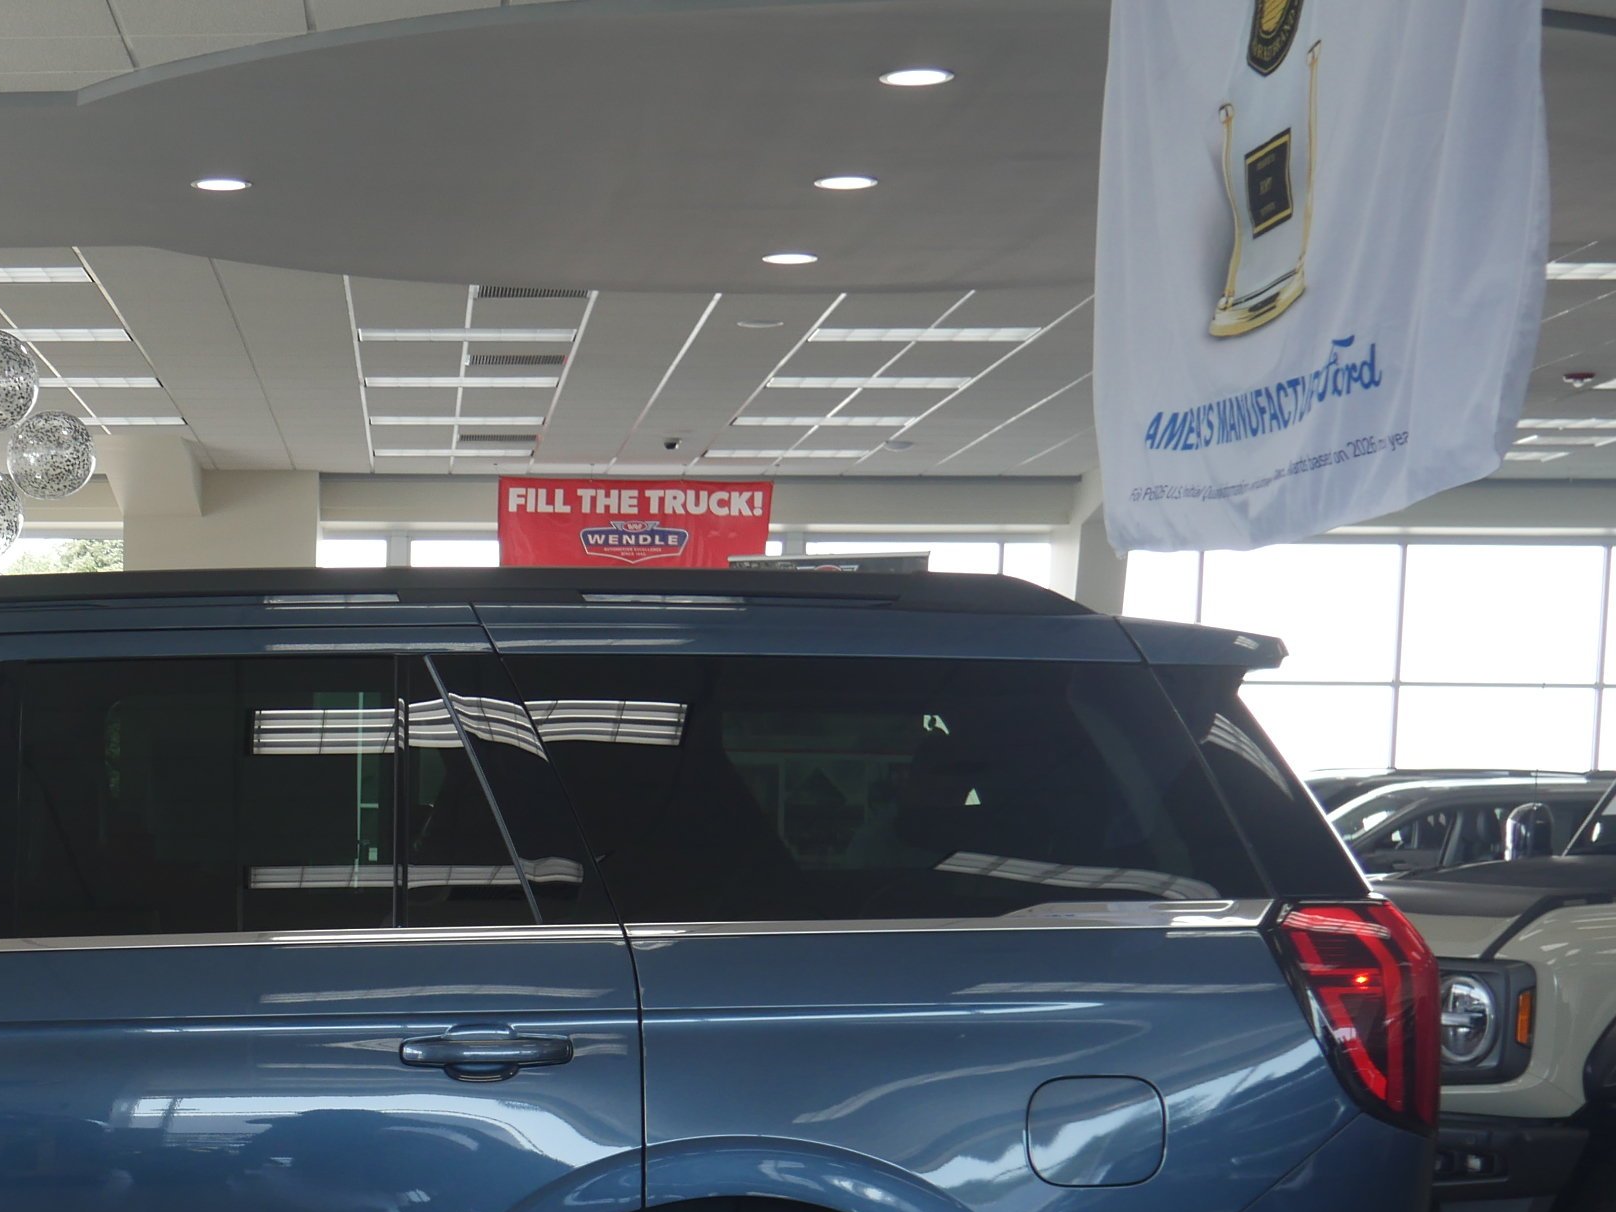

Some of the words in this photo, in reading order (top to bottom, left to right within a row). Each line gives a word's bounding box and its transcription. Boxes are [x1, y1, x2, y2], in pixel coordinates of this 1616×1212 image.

[1318, 334, 1382, 402] Ford
[508, 488, 571, 513] FILL
[577, 489, 639, 514] THE
[644, 490, 763, 516] TRUCK!
[587, 534, 679, 545] WENDLE
